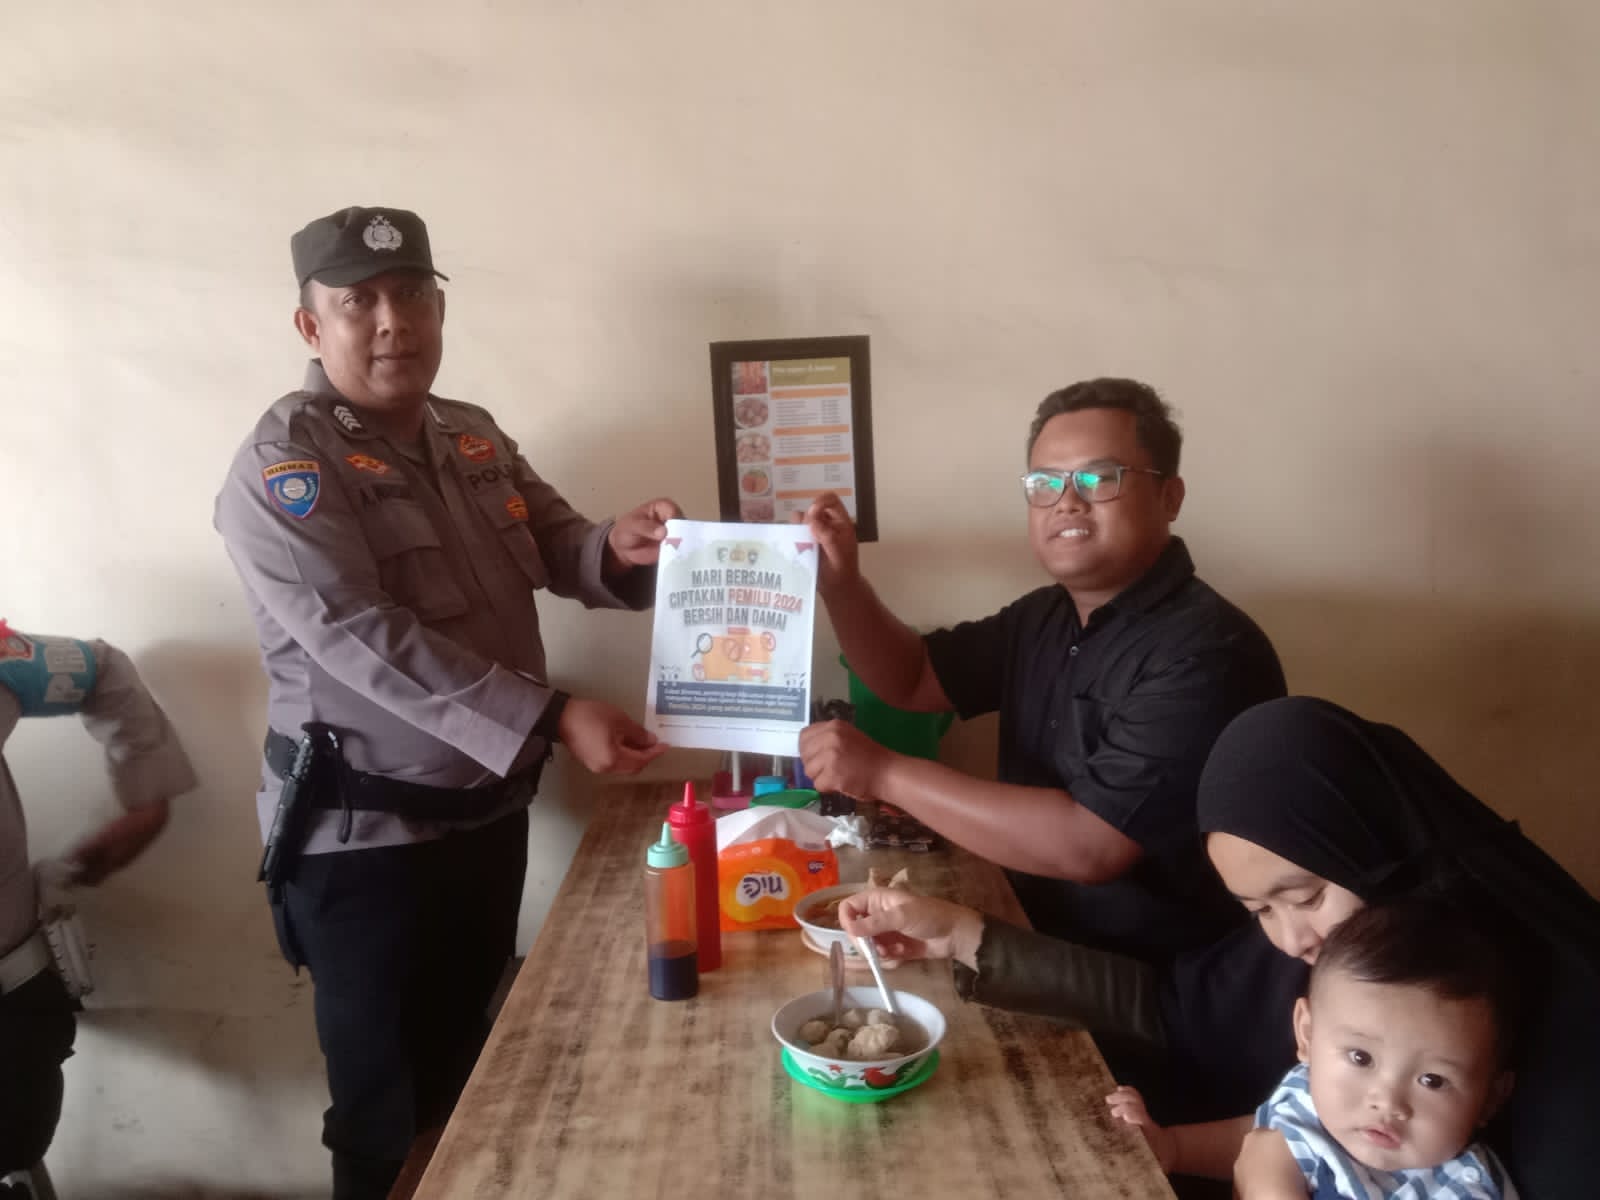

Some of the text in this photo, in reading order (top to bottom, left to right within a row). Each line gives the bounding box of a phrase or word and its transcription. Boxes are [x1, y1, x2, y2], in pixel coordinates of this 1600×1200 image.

[691, 569, 782, 591] MARI BERSAMA
[669, 587, 803, 613] CIPTAKAN PEMILU 2024
[683, 607, 787, 630] BERSIH DAN DAMAI
